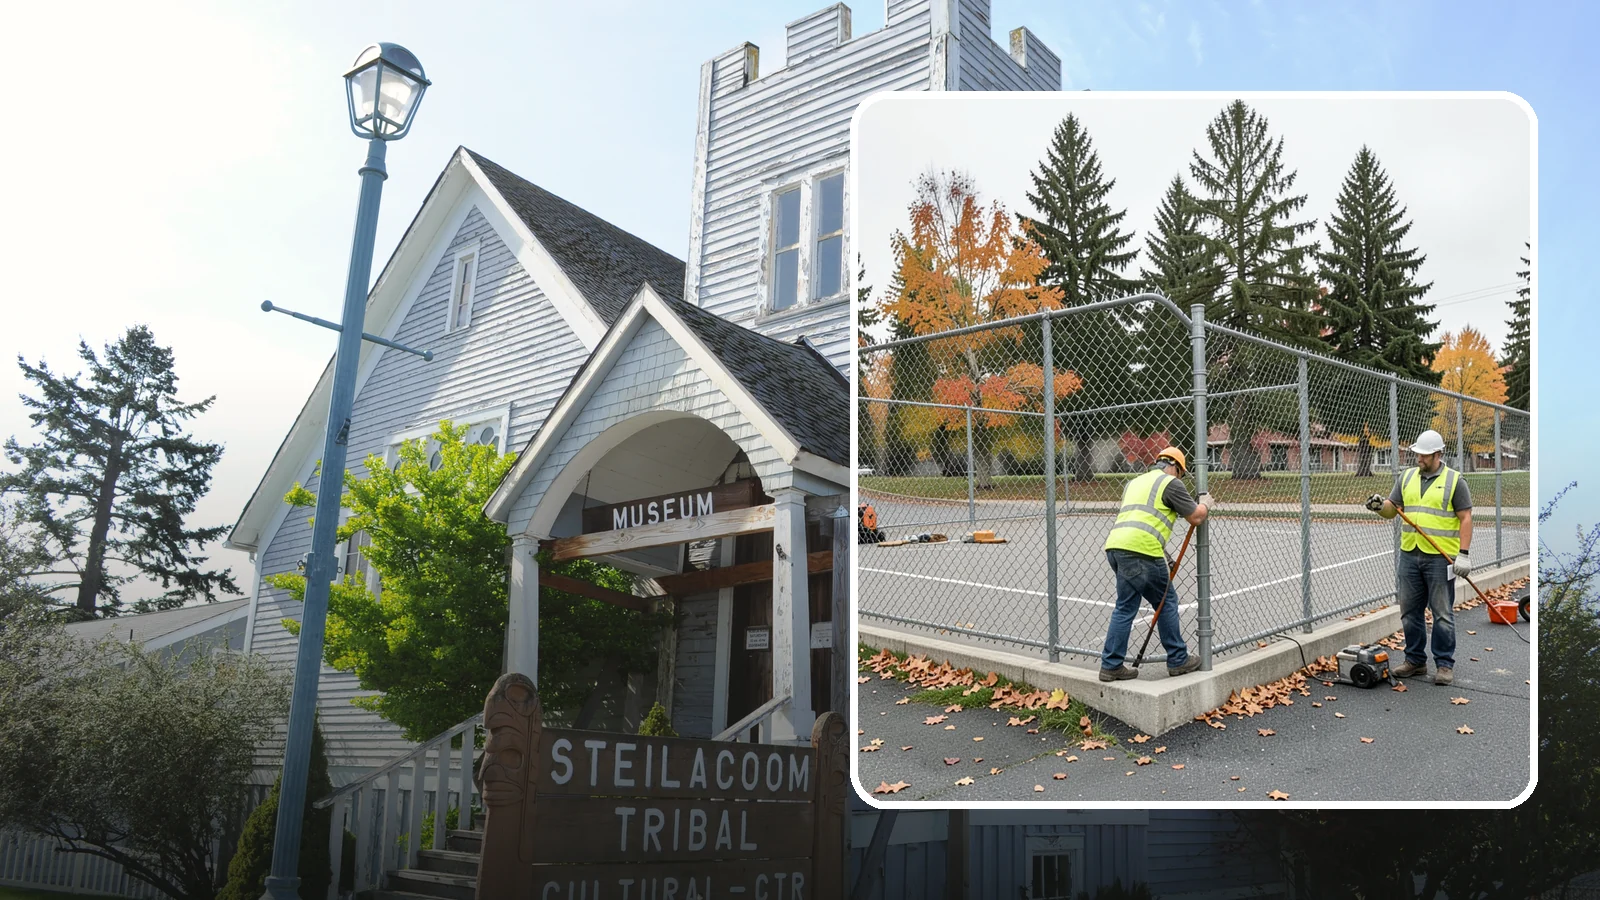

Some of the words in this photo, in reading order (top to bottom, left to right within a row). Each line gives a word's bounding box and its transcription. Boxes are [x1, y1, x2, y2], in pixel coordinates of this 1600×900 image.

[612, 492, 713, 530] MUSEUM
[550, 739, 809, 791] STEILACOOM
[615, 807, 757, 851] TRIBAL
